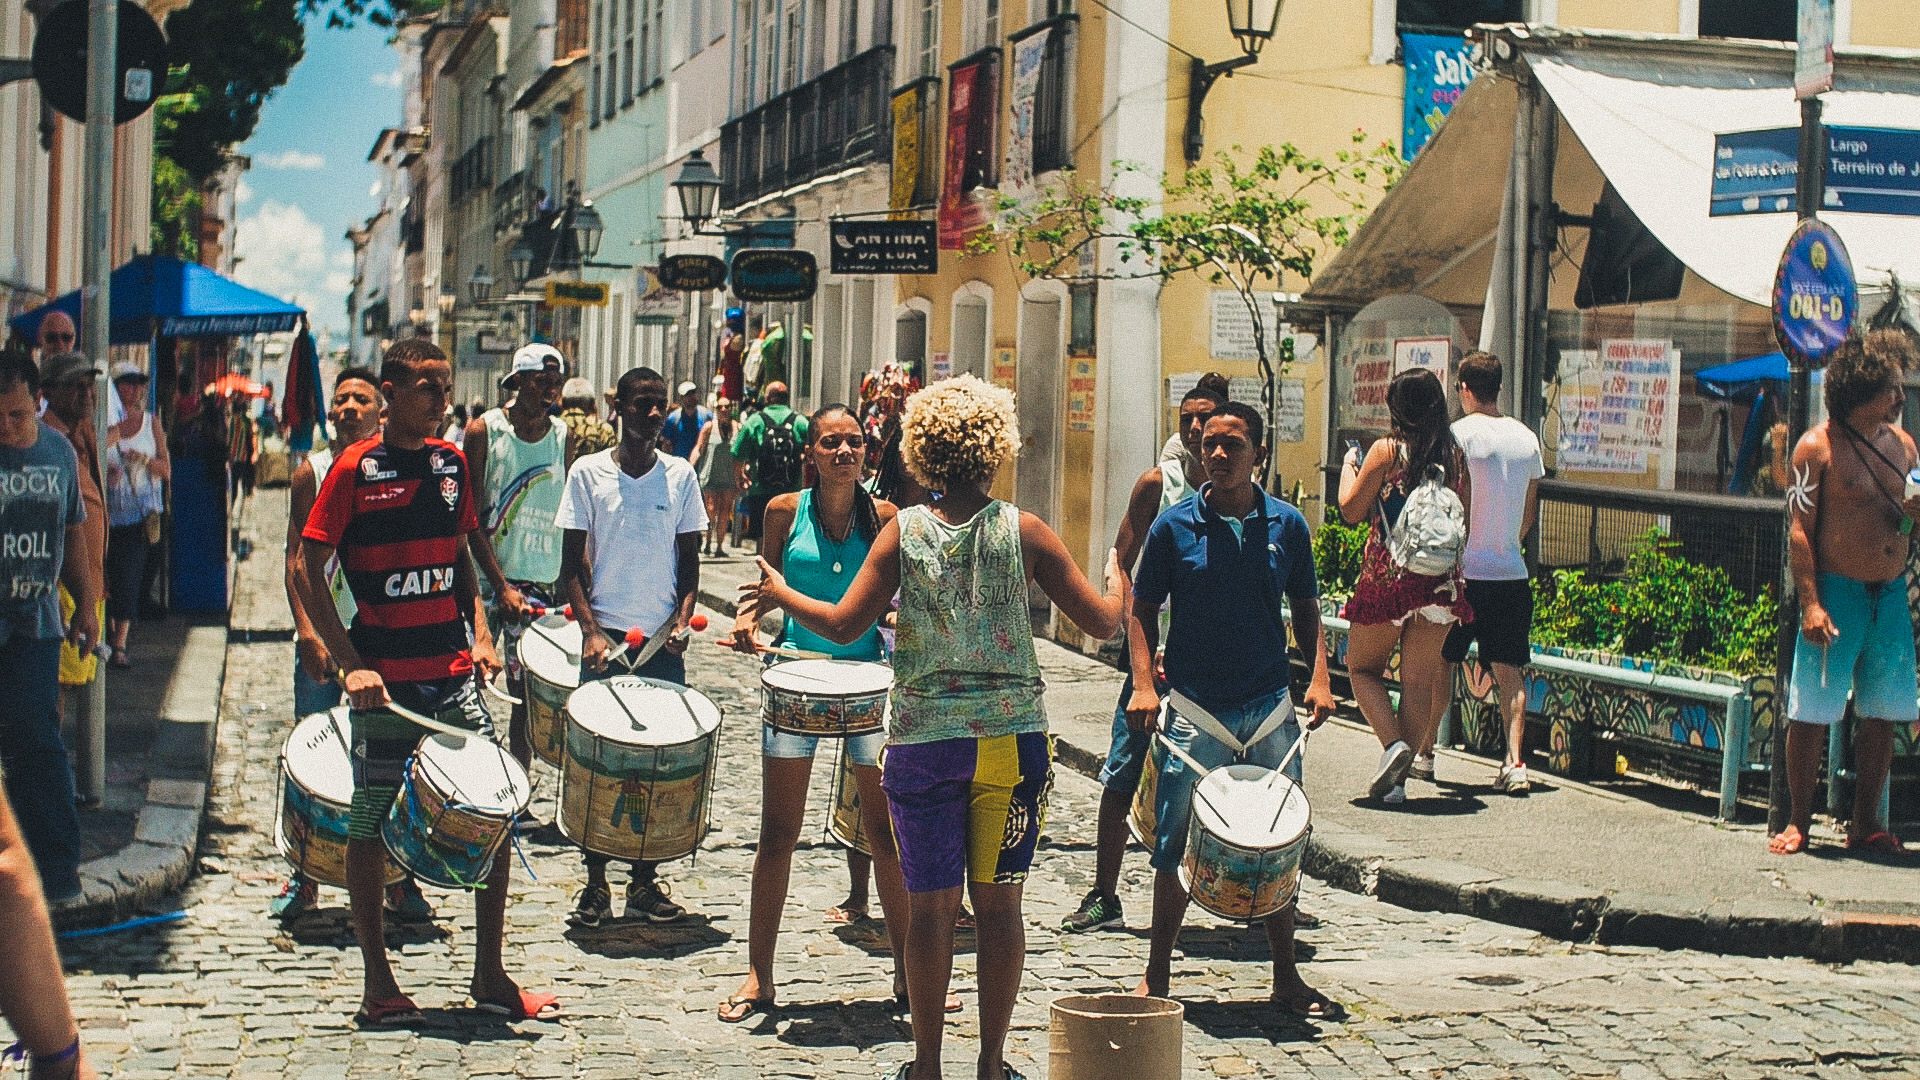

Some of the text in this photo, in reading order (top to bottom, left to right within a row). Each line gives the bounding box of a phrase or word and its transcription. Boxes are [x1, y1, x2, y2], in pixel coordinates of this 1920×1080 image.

[1830, 137, 1868, 155] Largo
[1830, 157, 1886, 176] Terreiro
[1888, 160, 1906, 177] de
[0, 471, 61, 496] ROCK
[3, 531, 52, 559] ROLL
